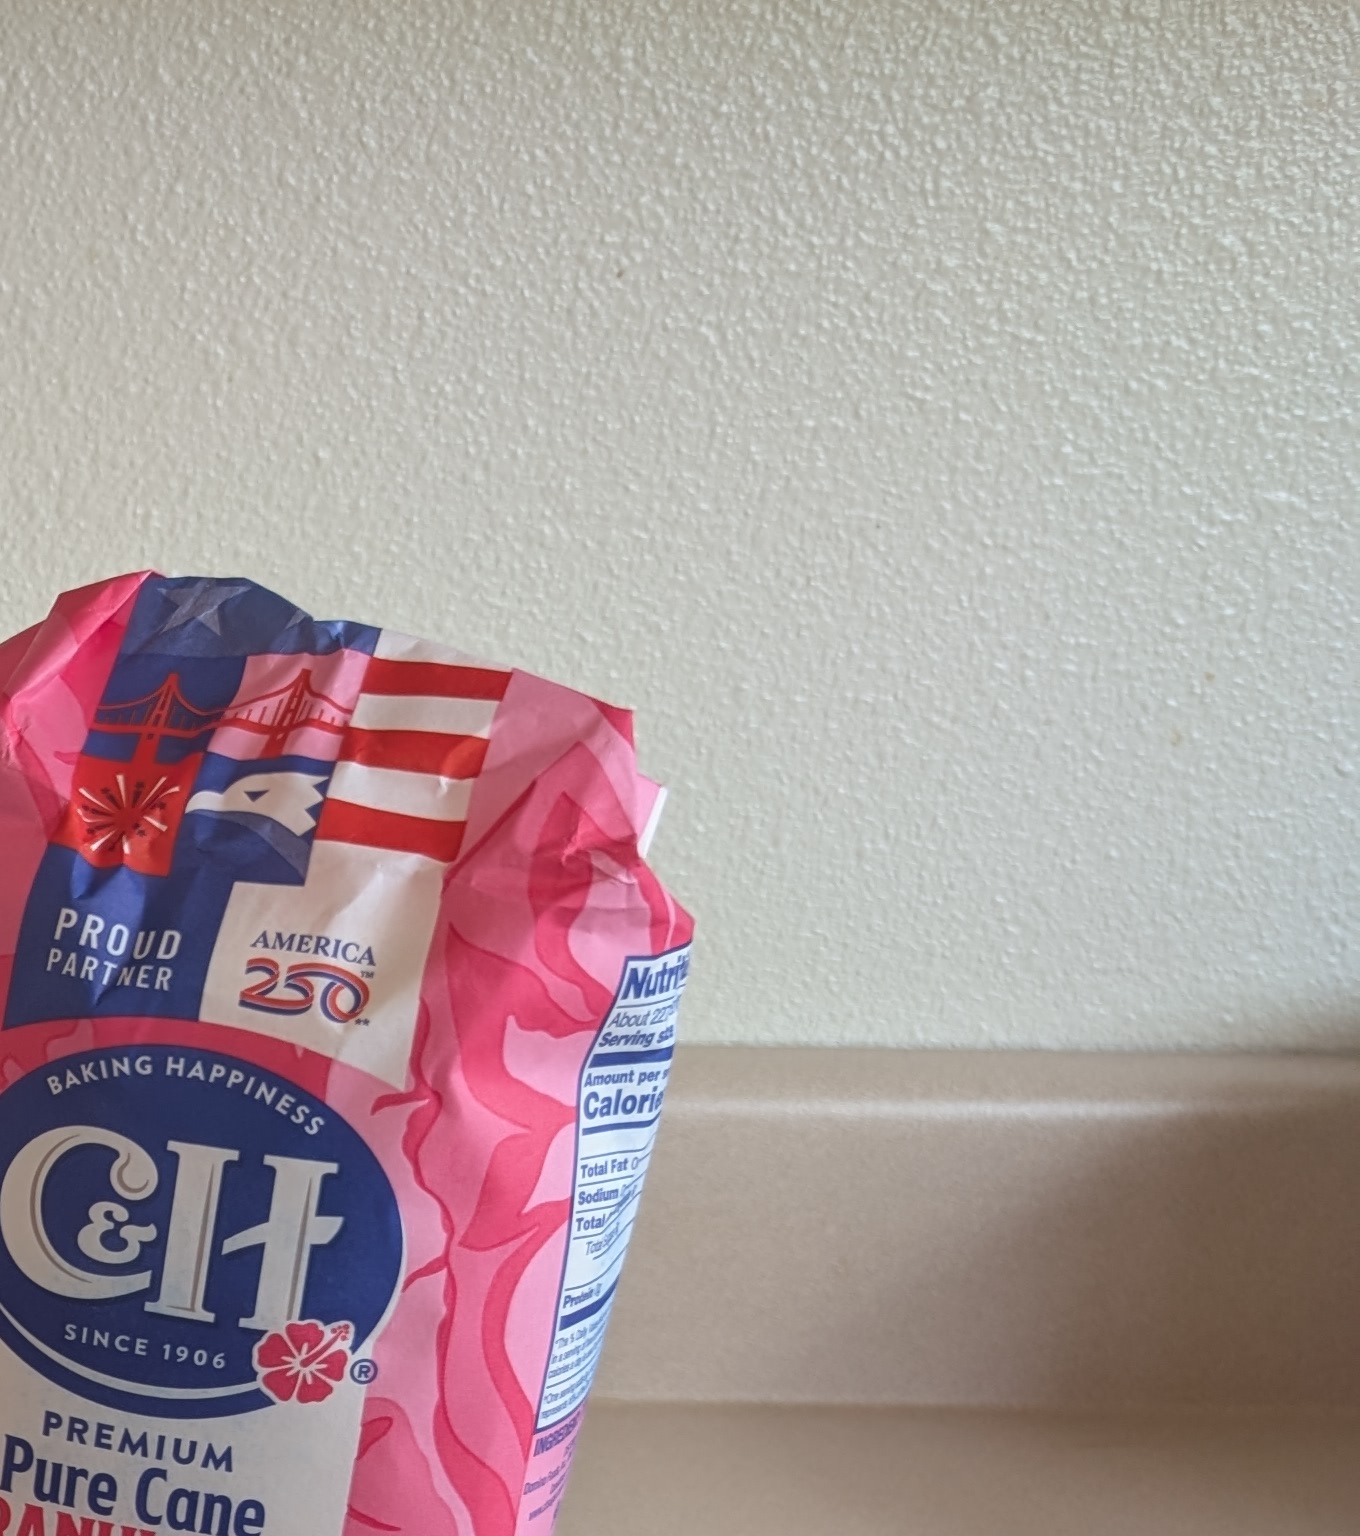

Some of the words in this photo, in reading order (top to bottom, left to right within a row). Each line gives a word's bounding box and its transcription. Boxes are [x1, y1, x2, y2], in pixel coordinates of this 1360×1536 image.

[54, 907, 182, 960] PROUD
[250, 930, 376, 966] AMERICA
[46, 948, 173, 991] PARTNER
[238, 957, 370, 1023] 250
[607, 1011, 650, 1028] About
[599, 1030, 655, 1048] Serving
[46, 1055, 154, 1096] BAKING
[165, 1056, 325, 1136] HAPPINESS
[584, 1070, 635, 1087] Amount
[637, 1071, 661, 1086] per
[584, 1086, 664, 1120] Calorie
[581, 1161, 608, 1179] Total
[611, 1158, 628, 1173] Fat
[578, 1188, 619, 1205] Sodium
[576, 1213, 606, 1232] Total
[64, 1322, 149, 1357] SINCE
[161, 1342, 227, 1370] 1906
[41, 1411, 234, 1473] PREMIUM
[0, 1434, 118, 1515] Pure
